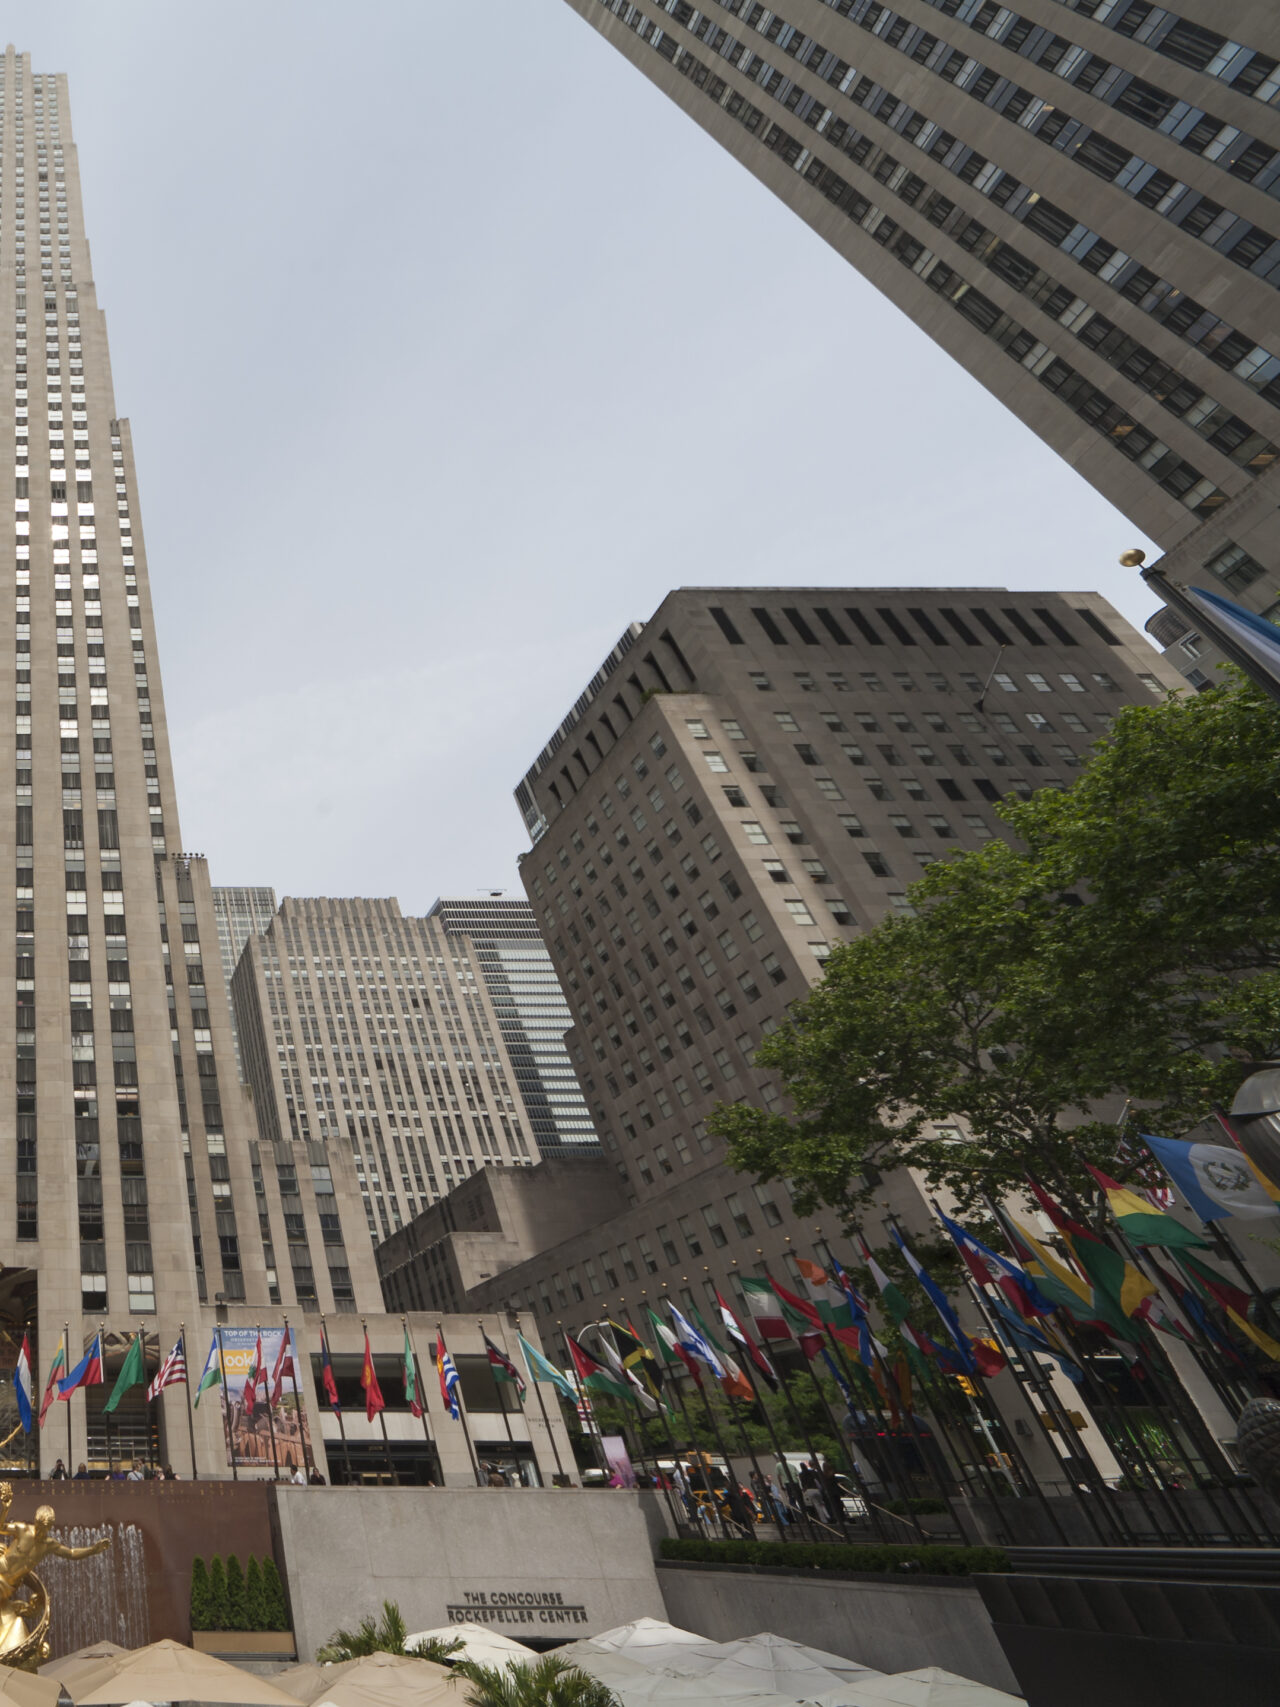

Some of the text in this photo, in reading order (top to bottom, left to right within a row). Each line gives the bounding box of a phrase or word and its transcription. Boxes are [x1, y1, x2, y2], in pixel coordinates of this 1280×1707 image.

[463, 1592, 564, 1605] THE CONCOURSE
[447, 1610, 589, 1624] ROCKEFELLER CENTER
